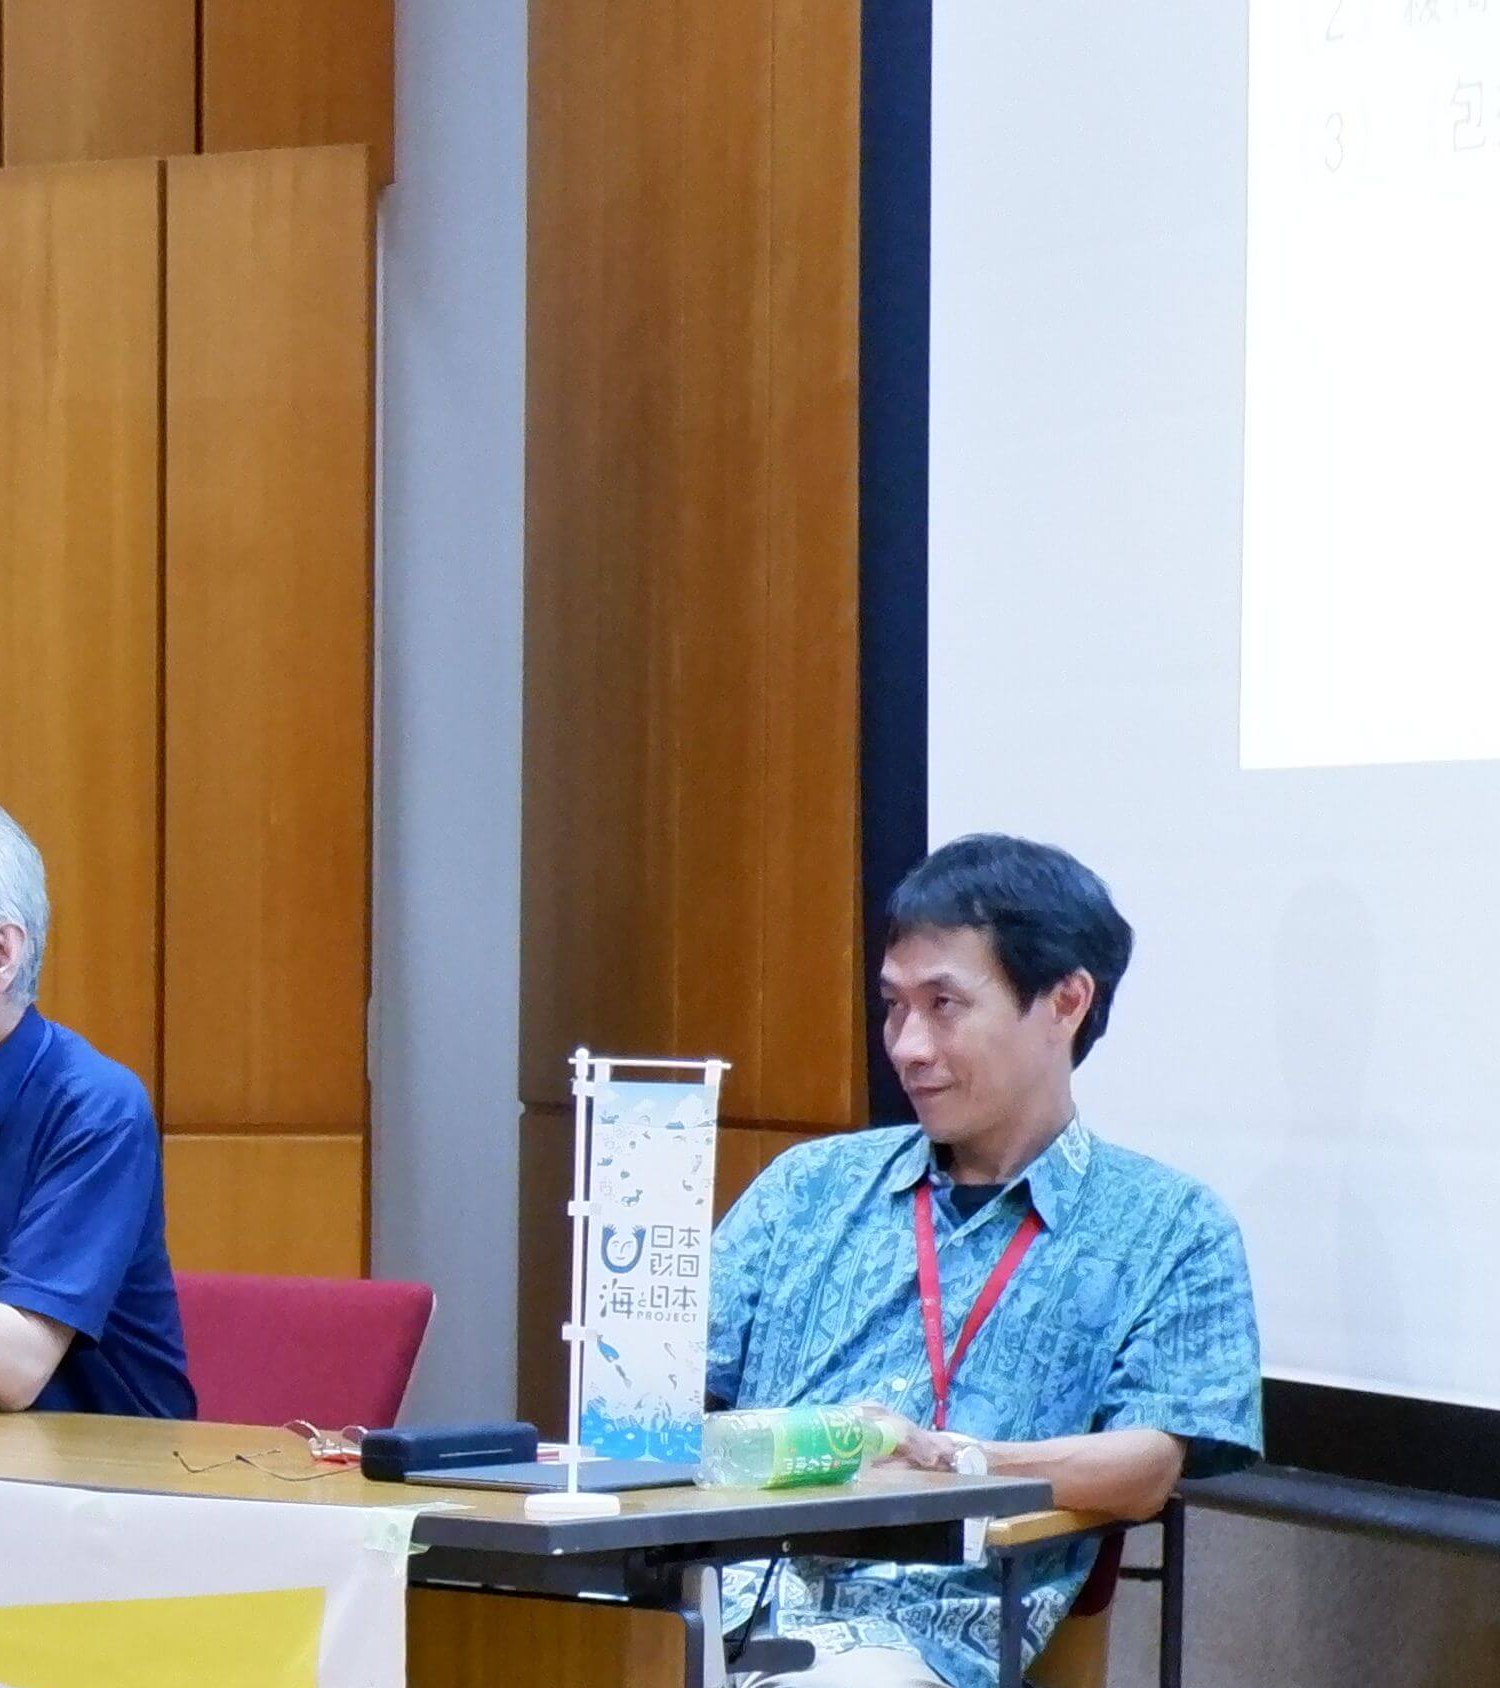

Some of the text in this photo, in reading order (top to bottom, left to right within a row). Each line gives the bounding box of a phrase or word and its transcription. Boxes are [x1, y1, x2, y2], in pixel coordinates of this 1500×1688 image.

[651, 1224, 701, 1249] 日本
[650, 1252, 700, 1278] 財団
[598, 1277, 698, 1320] 海と日本
[636, 1311, 698, 1323] PROJECT
